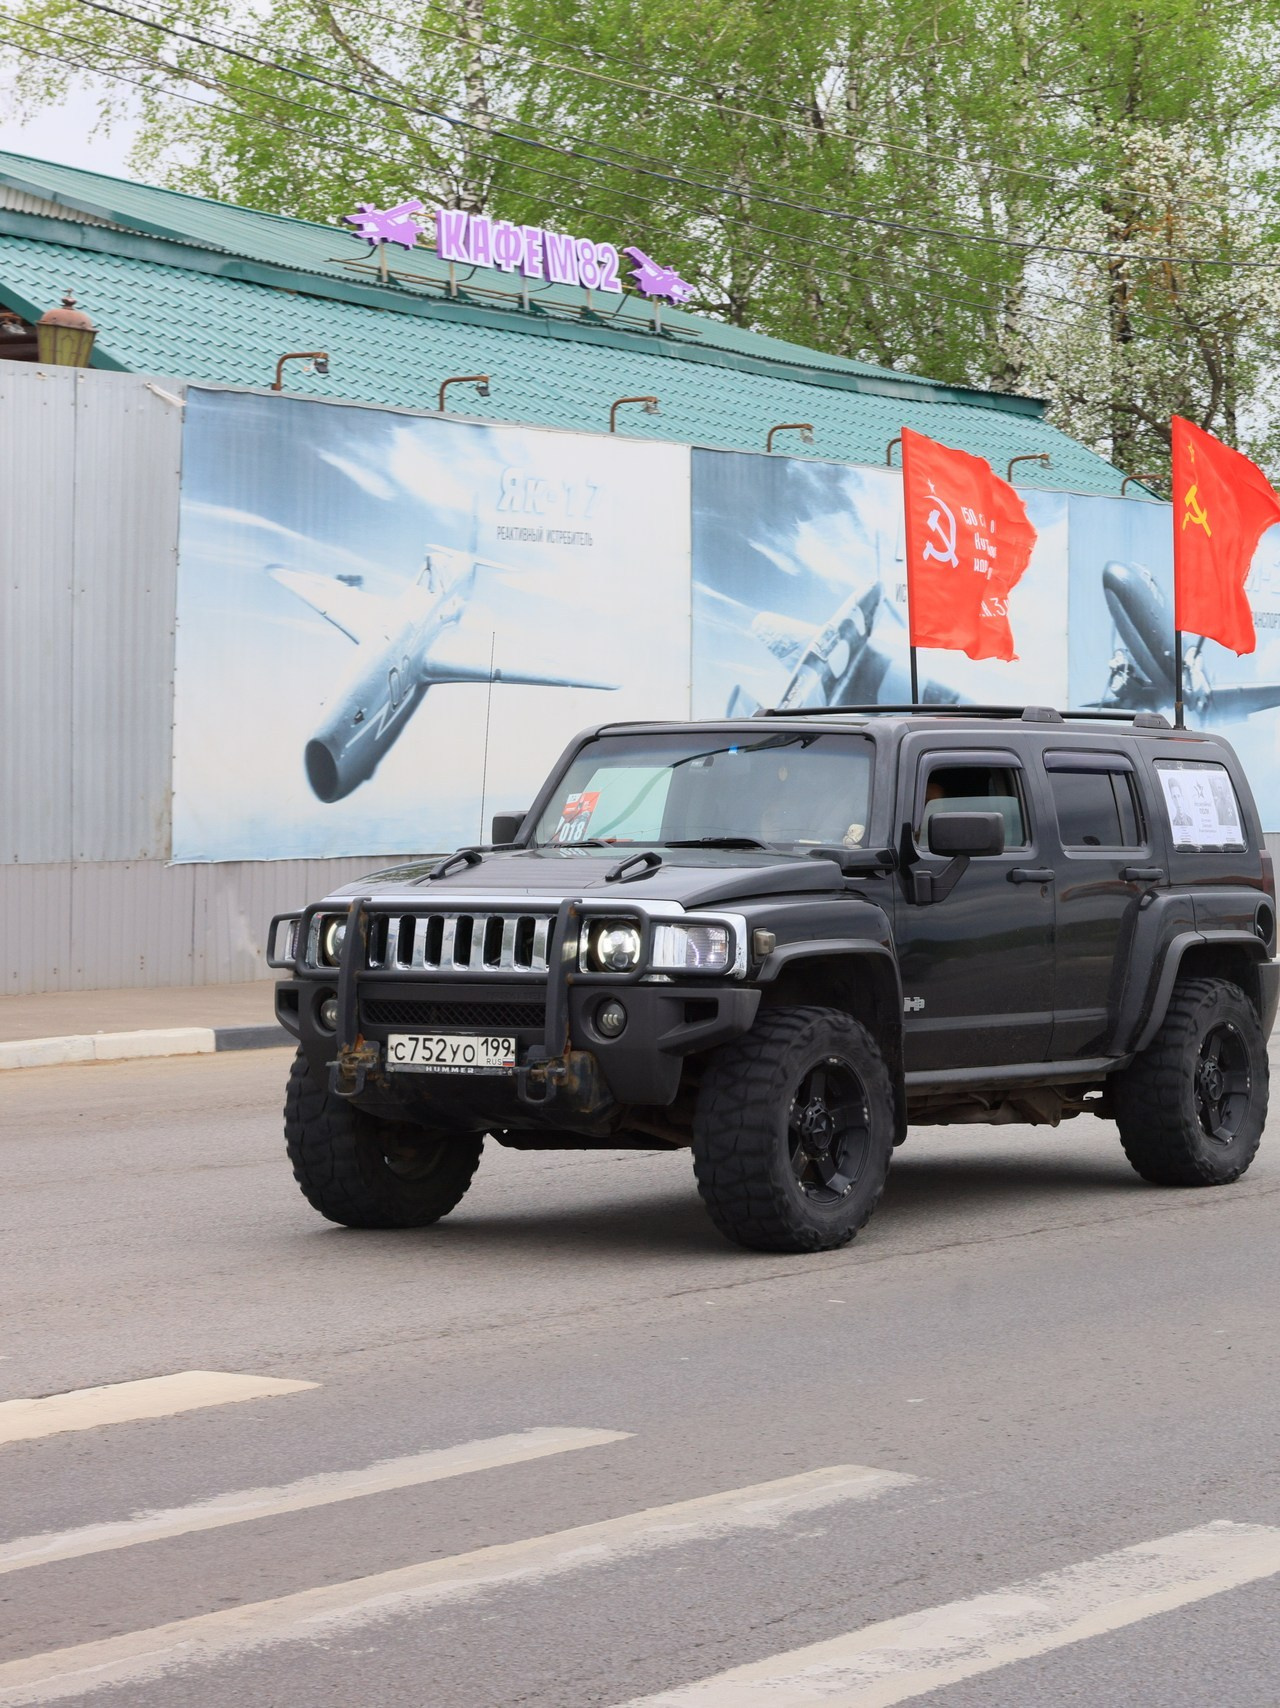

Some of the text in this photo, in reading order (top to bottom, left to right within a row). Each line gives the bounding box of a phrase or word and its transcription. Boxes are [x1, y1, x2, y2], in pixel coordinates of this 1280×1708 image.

[436, 208, 622, 294] КАФЕ М82
[496, 525, 594, 547] РЕАКТИВНЫЙ ИСТРЕБИТЕЛЬ
[394, 1036, 512, 1063] С752УО 199
[425, 1066, 475, 1074] HUMMER
[486, 1058, 502, 1066] RUS
